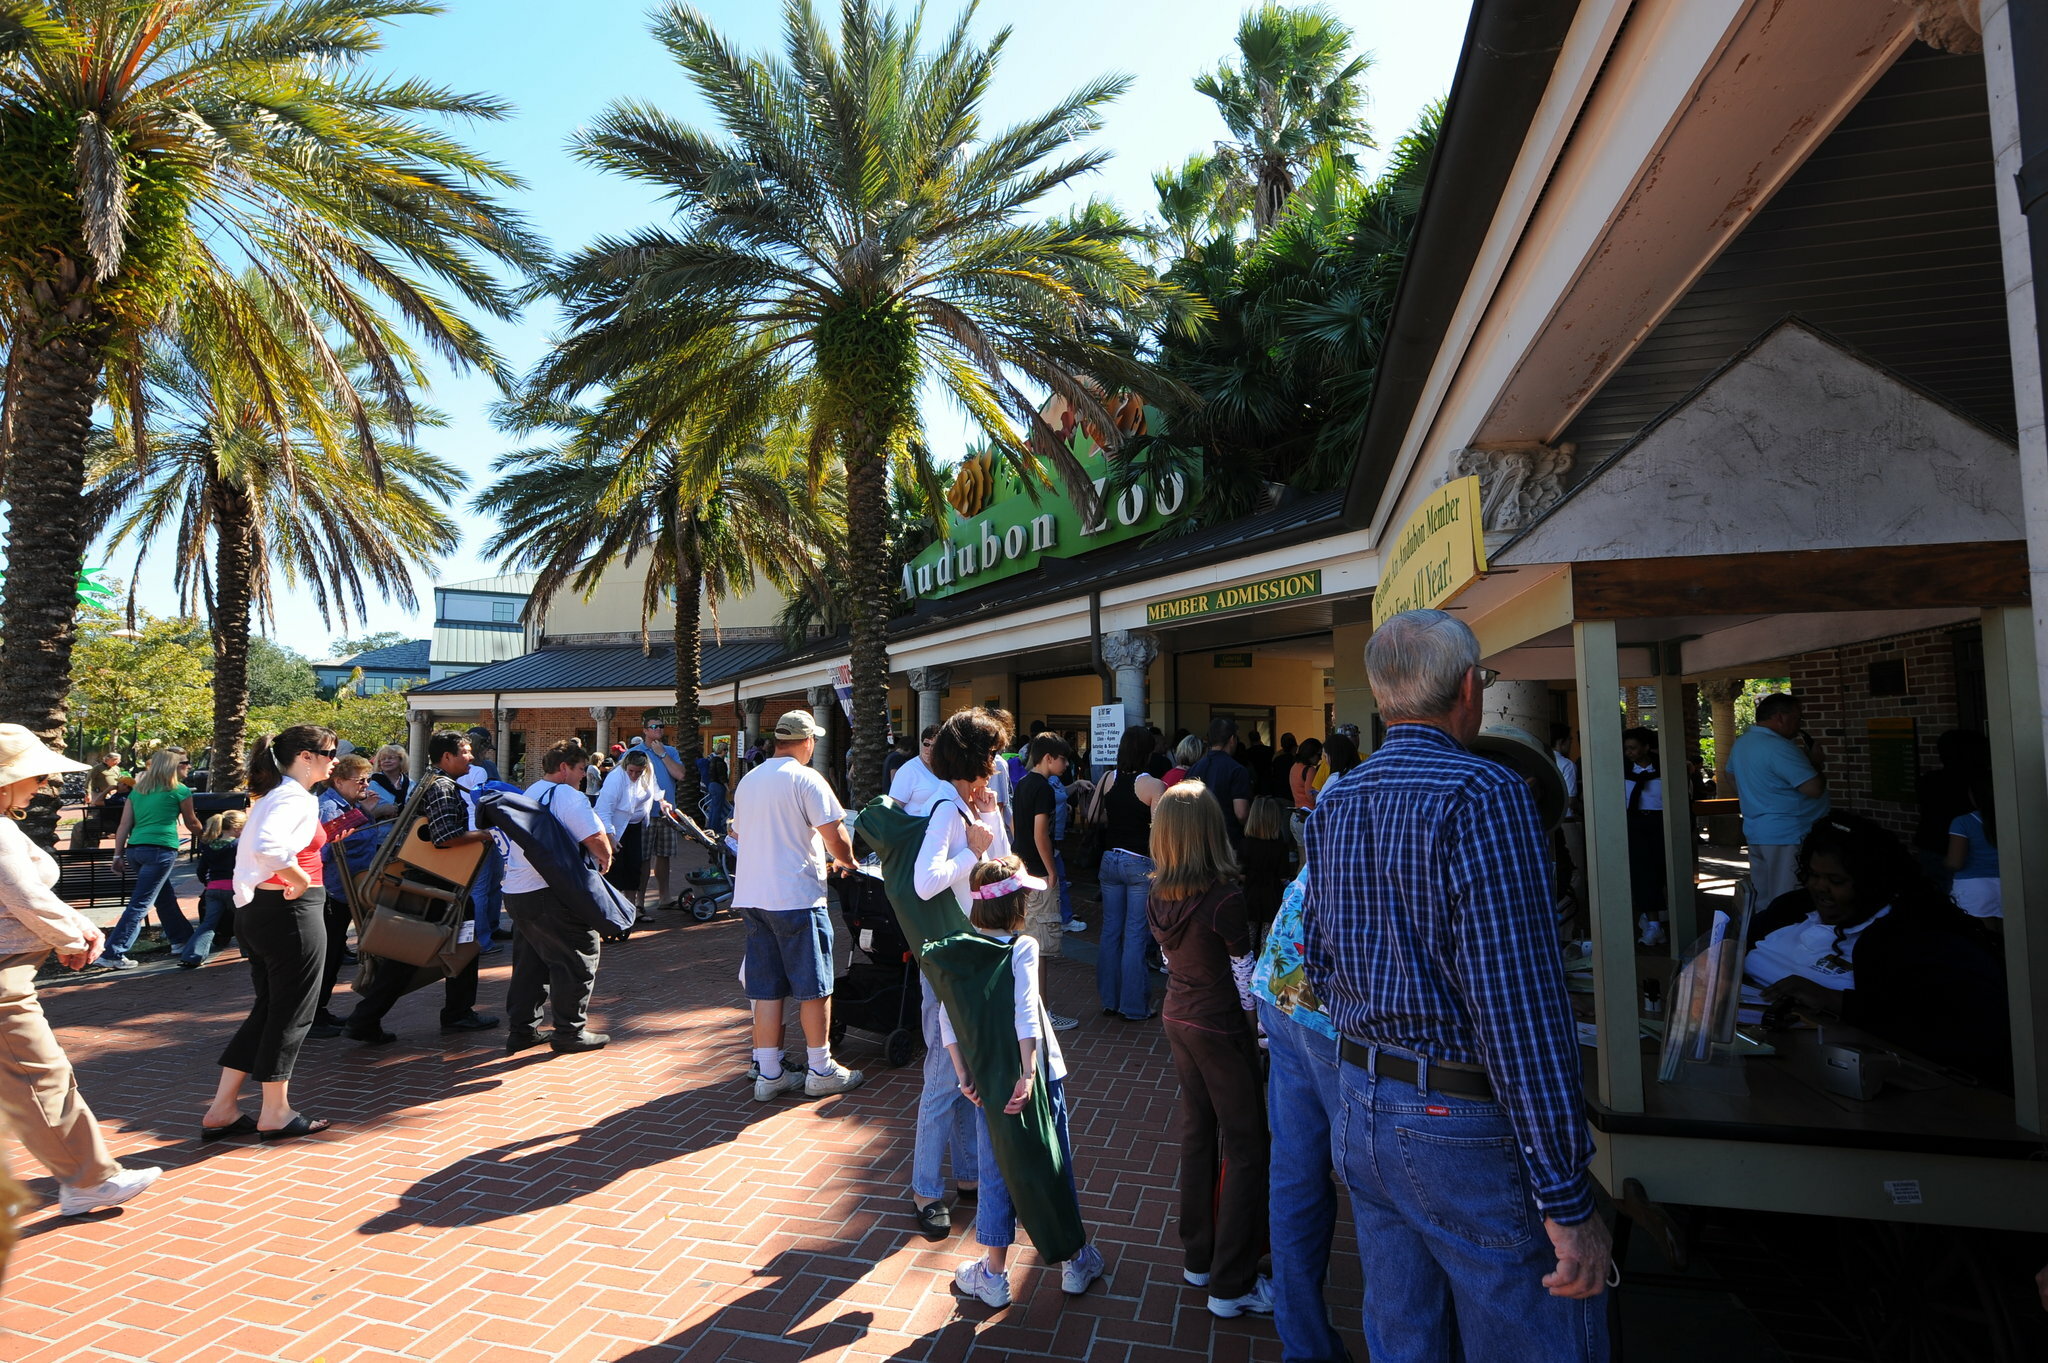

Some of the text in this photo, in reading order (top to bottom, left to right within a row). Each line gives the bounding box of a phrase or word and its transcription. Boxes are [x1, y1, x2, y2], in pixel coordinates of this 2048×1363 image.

[900, 469, 1188, 602] Audubon Zoo
[1399, 523, 1426, 570] Audubon
[1426, 490, 1460, 538] Member
[1148, 573, 1317, 622] MEMBER ADMISSION
[1413, 568, 1426, 610] All
[1425, 541, 1453, 602] Year!
